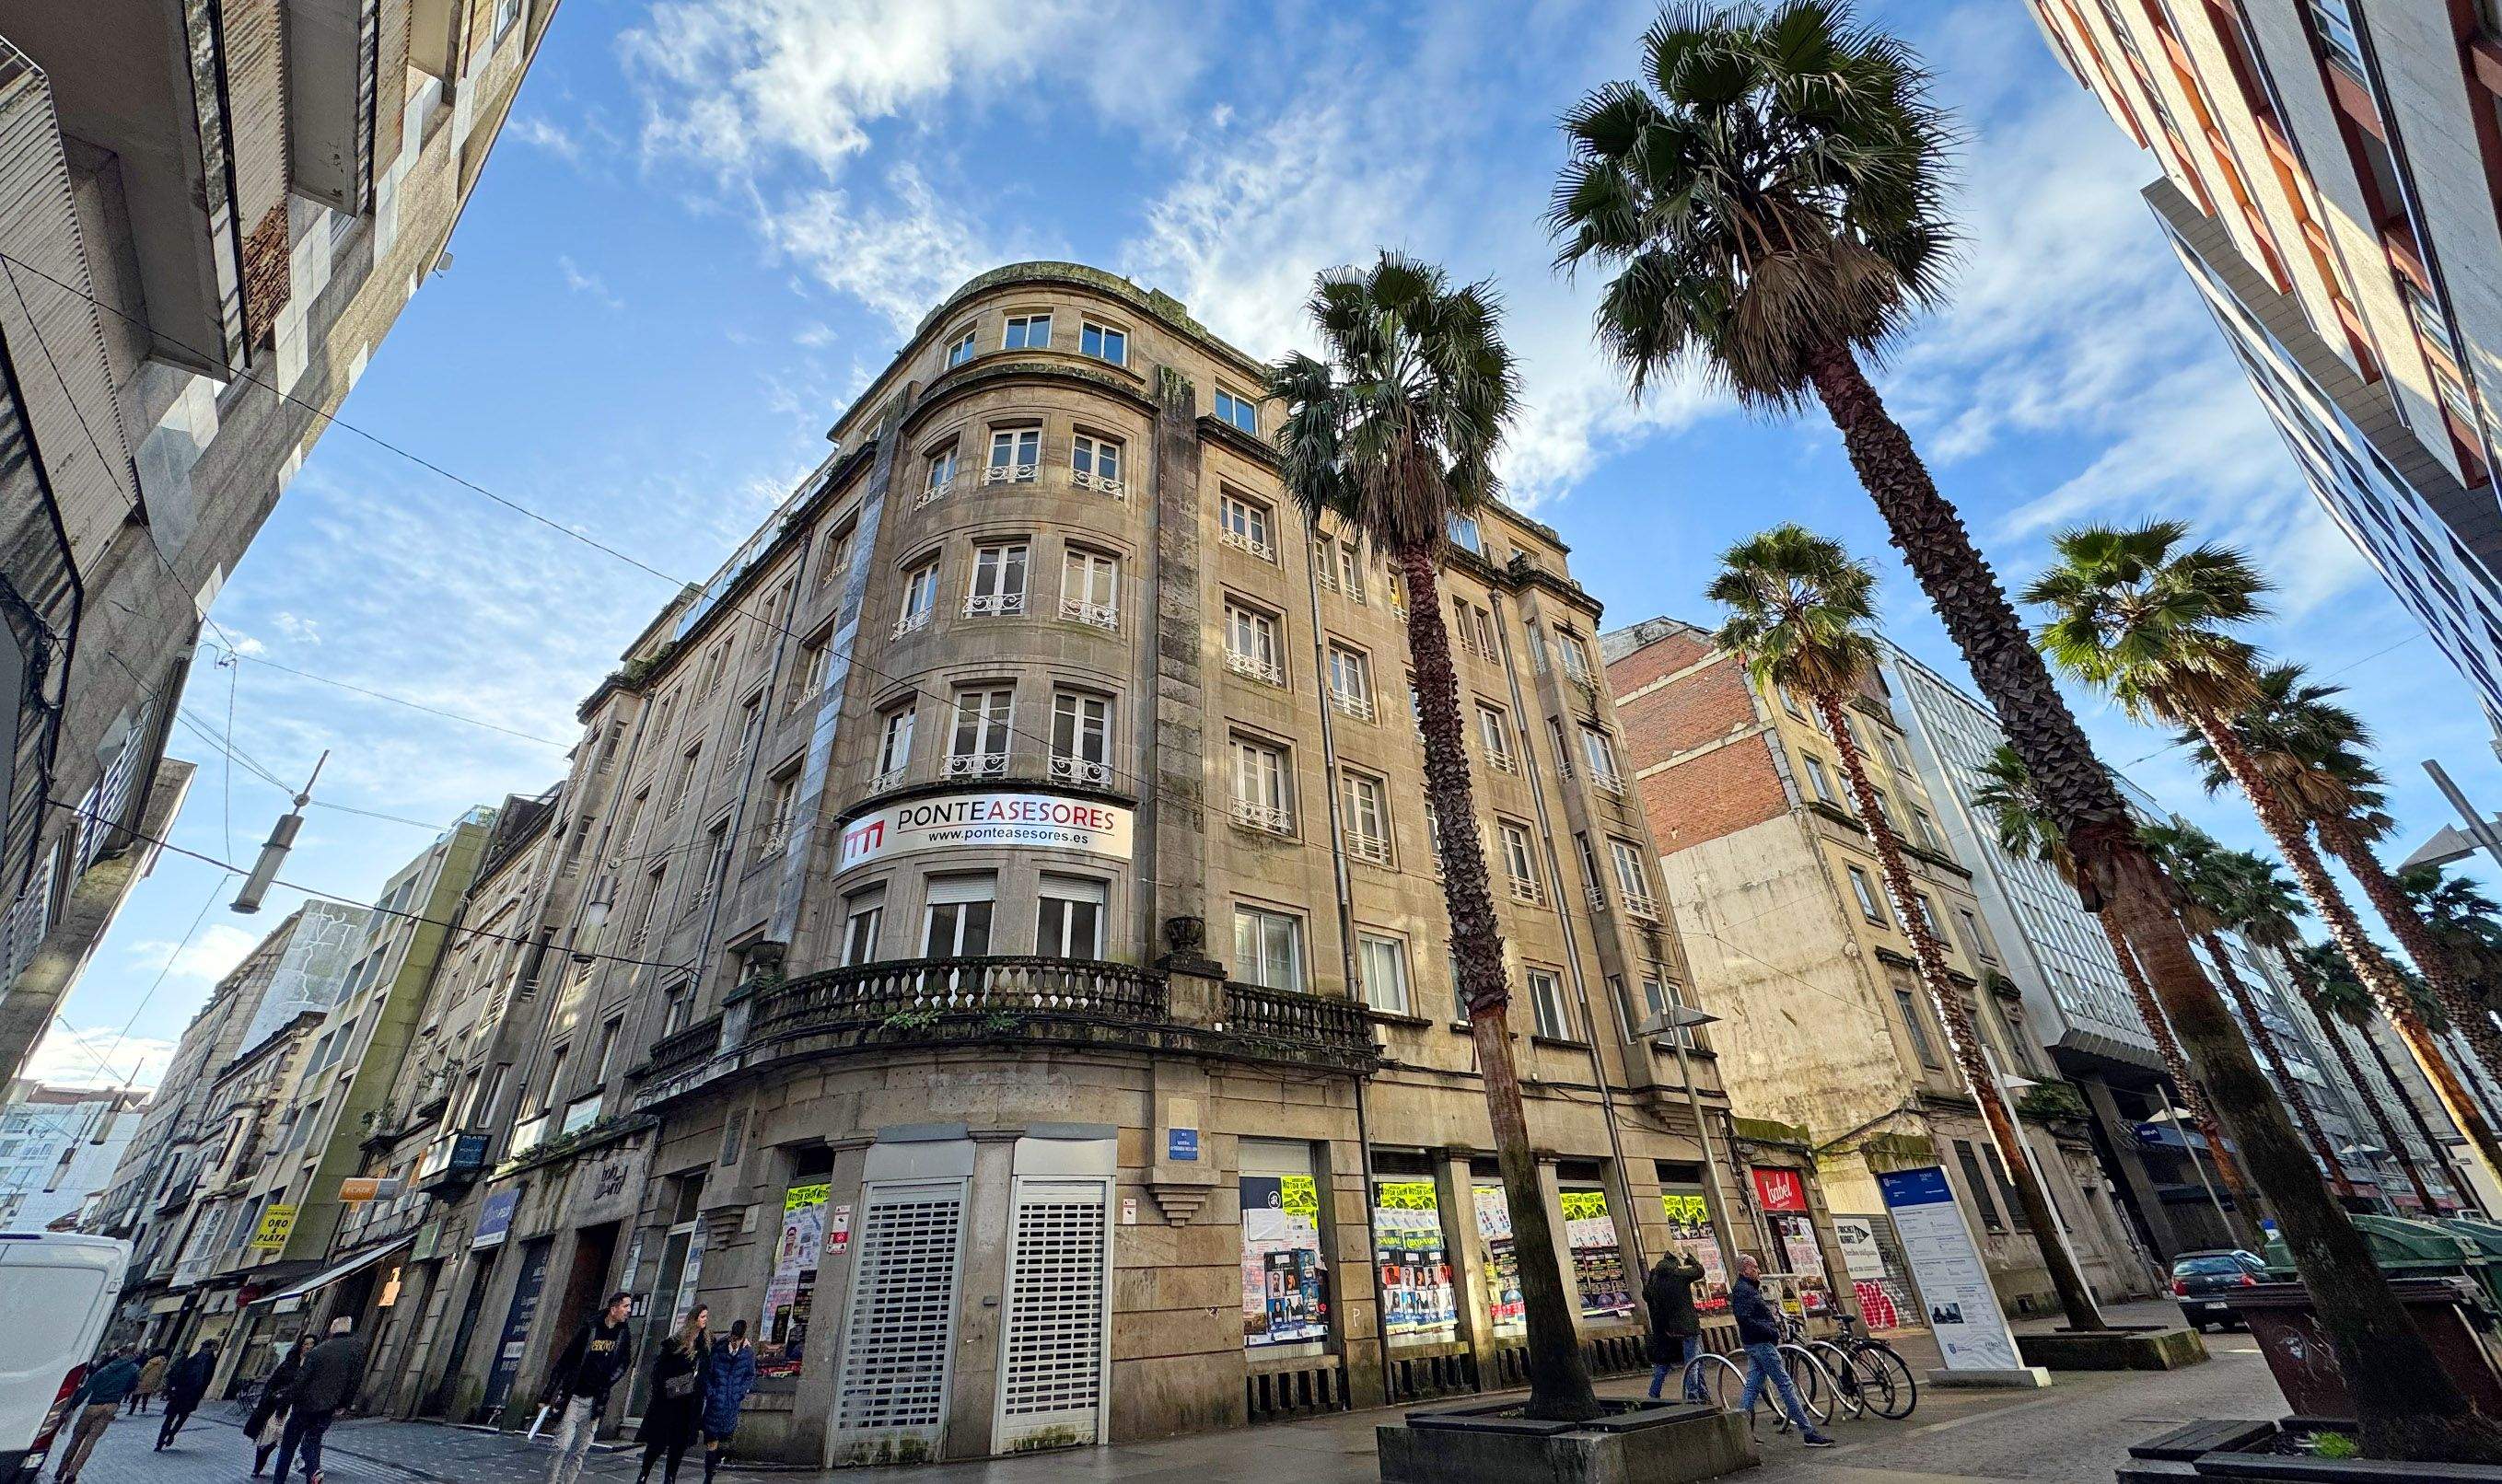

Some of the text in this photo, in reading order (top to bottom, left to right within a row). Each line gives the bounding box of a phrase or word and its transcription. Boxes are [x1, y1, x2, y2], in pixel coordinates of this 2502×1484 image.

[898, 800, 1114, 829] PONTEASESORES
[928, 827, 1088, 844] www.ponteasesores.es
[1765, 1171, 1793, 1204] Isabel
[268, 1219, 288, 1228] ORO
[256, 1234, 286, 1242] PLATA
